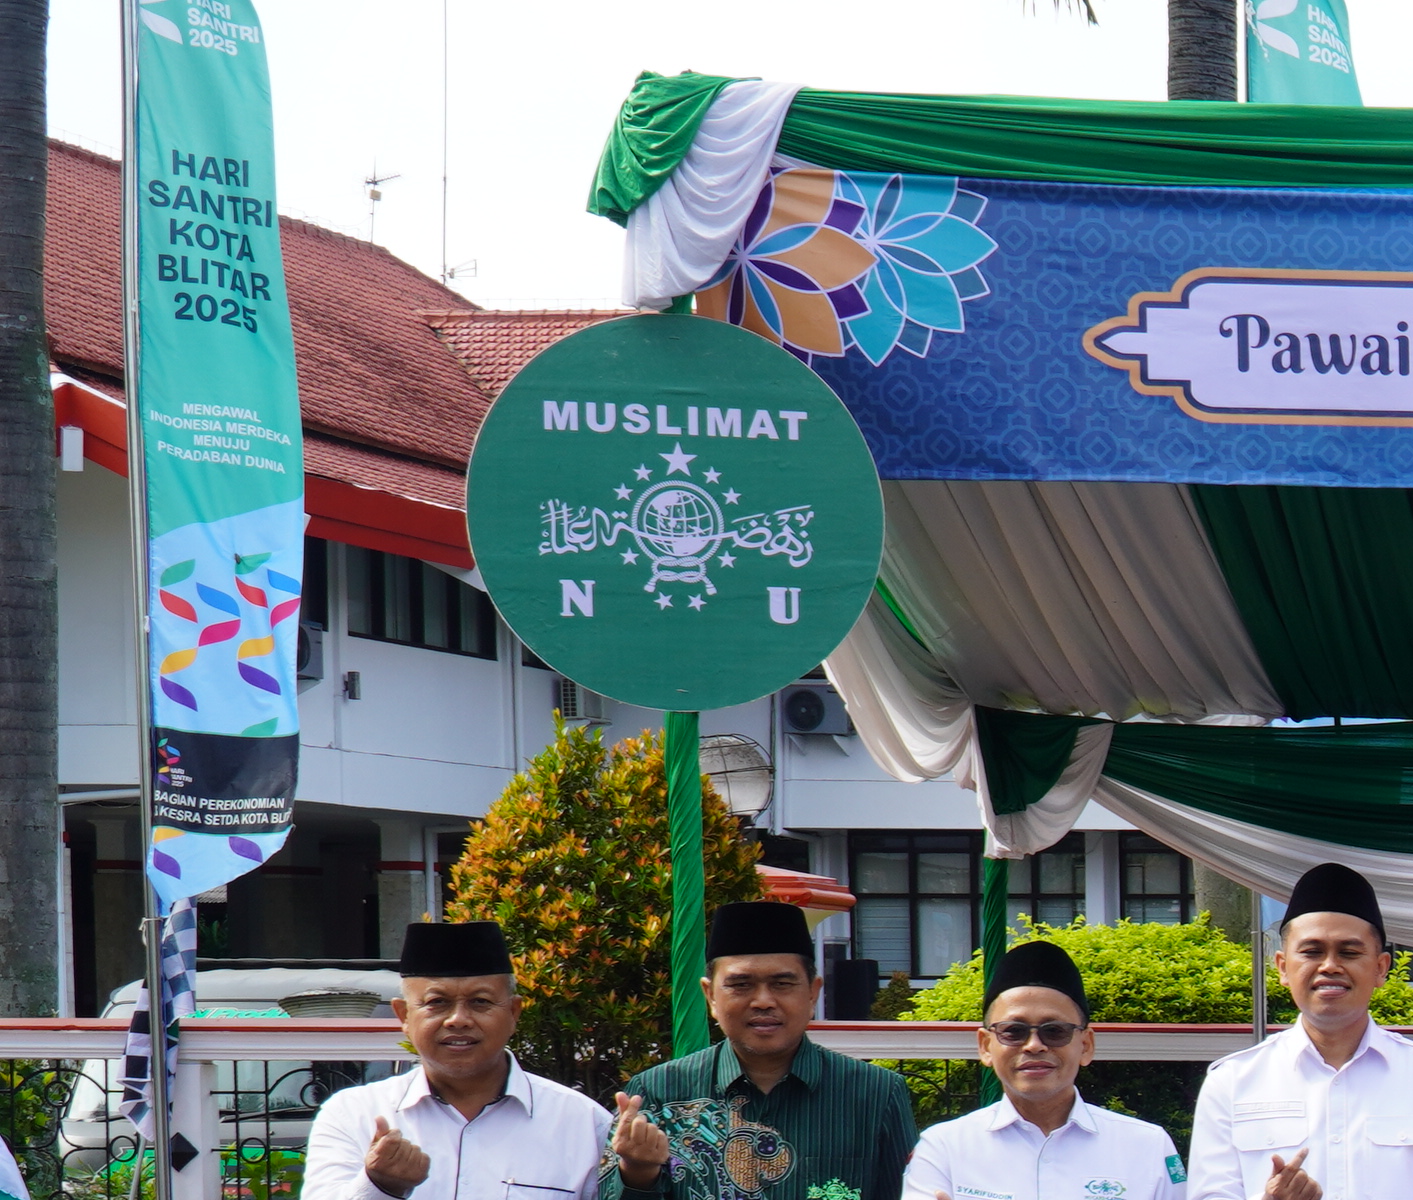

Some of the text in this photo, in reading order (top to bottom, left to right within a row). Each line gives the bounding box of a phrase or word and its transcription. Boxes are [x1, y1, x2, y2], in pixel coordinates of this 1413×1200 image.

[187, 0, 231, 20] ARI
[187, 7, 260, 43] SANTRI
[189, 28, 238, 56] 2025
[1308, 44, 1350, 74] 2025
[172, 149, 249, 188] HARI
[148, 180, 273, 228] SANTRI
[169, 218, 256, 263] KOTA
[158, 254, 271, 301] BLITAR
[174, 292, 258, 334] 2025
[1219, 314, 1410, 376] Pawai
[150, 410, 291, 446] INDONESIA MERDEKA
[183, 403, 262, 423] MENGAWAL
[543, 400, 808, 440] MUSLIMAT
[157, 440, 286, 474] PERADABAN DUNIA
[193, 434, 250, 451] MENUJU
[559, 579, 802, 625] N U
[154, 790, 196, 808] BAGIAN
[159, 806, 202, 824] KESRA
[204, 813, 240, 826] SETDA
[241, 813, 269, 825] KOTA
[199, 798, 285, 811] PEREKONOMIAN
[957, 1186, 1013, 1200] SYARIFUDDIN
